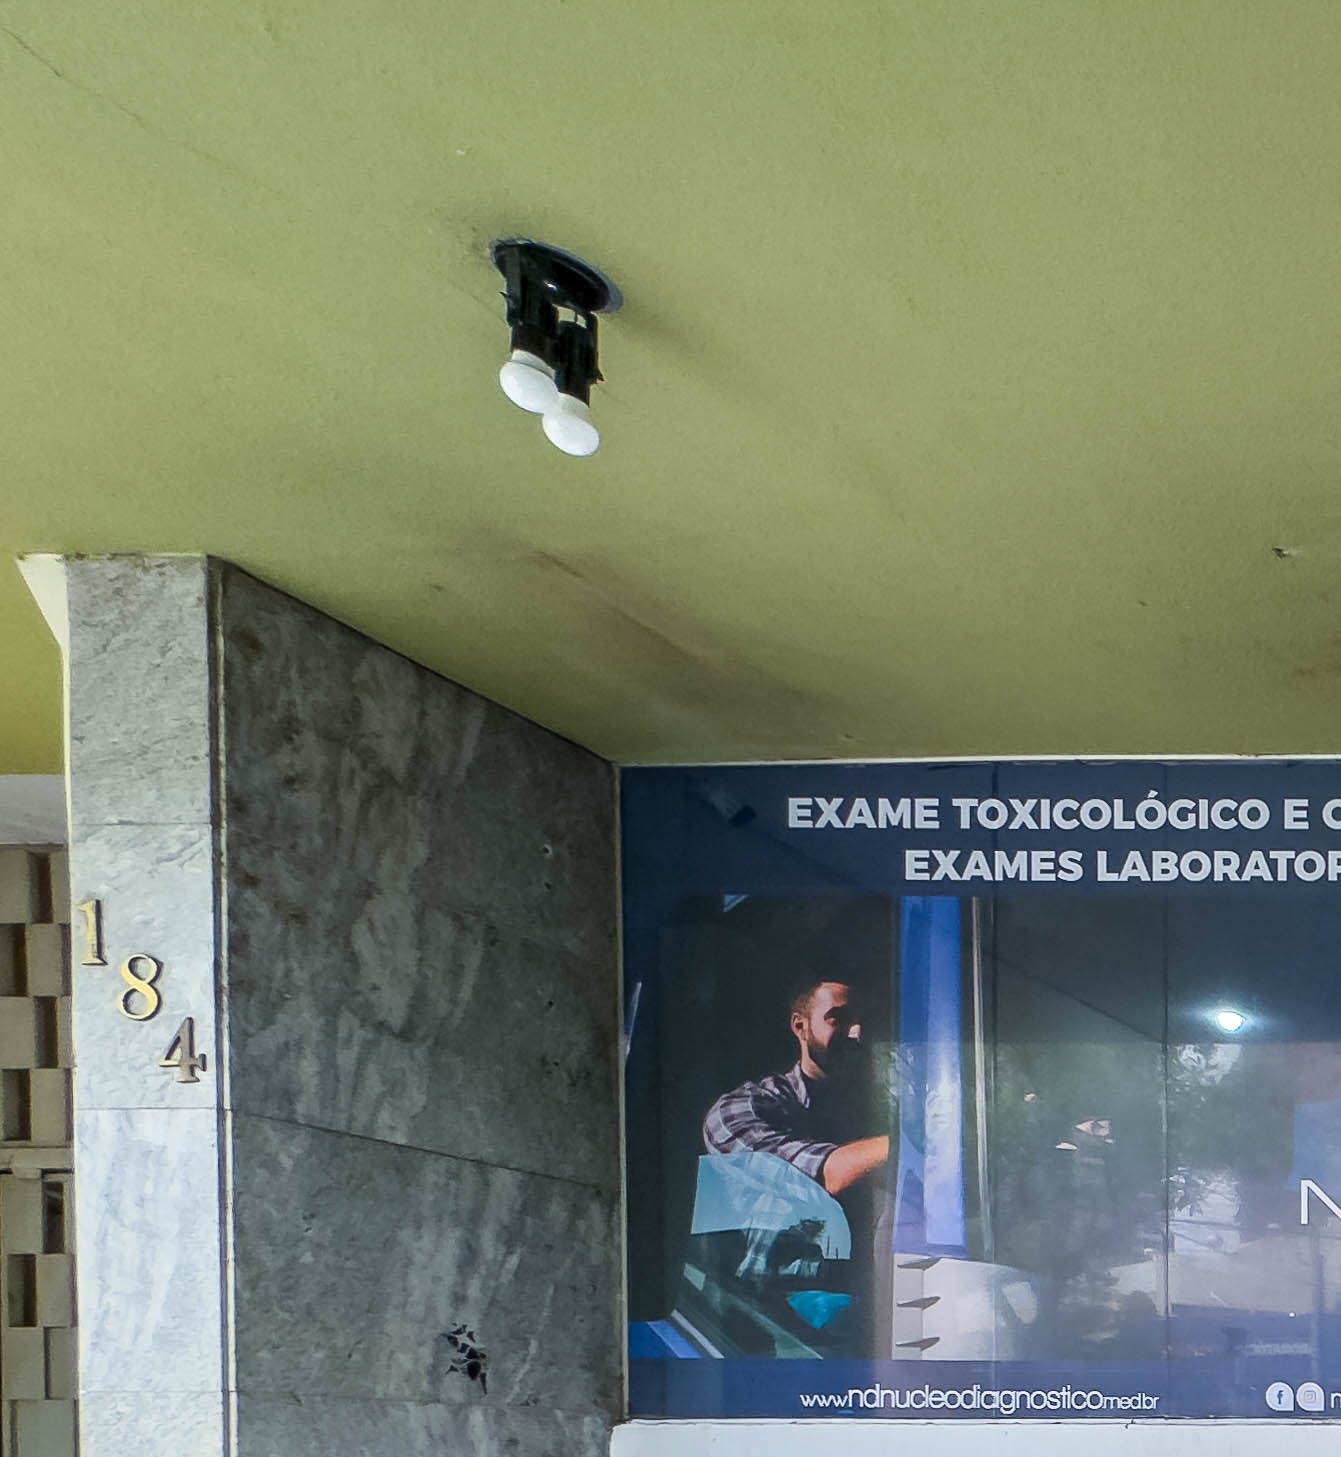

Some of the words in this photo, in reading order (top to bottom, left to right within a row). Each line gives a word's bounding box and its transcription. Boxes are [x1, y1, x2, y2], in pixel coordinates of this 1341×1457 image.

[787, 797, 940, 829] EXAME
[951, 789, 1270, 830] TOXICOLÓGICO
[1283, 798, 1309, 830] E
[904, 849, 1084, 882] EXAMES
